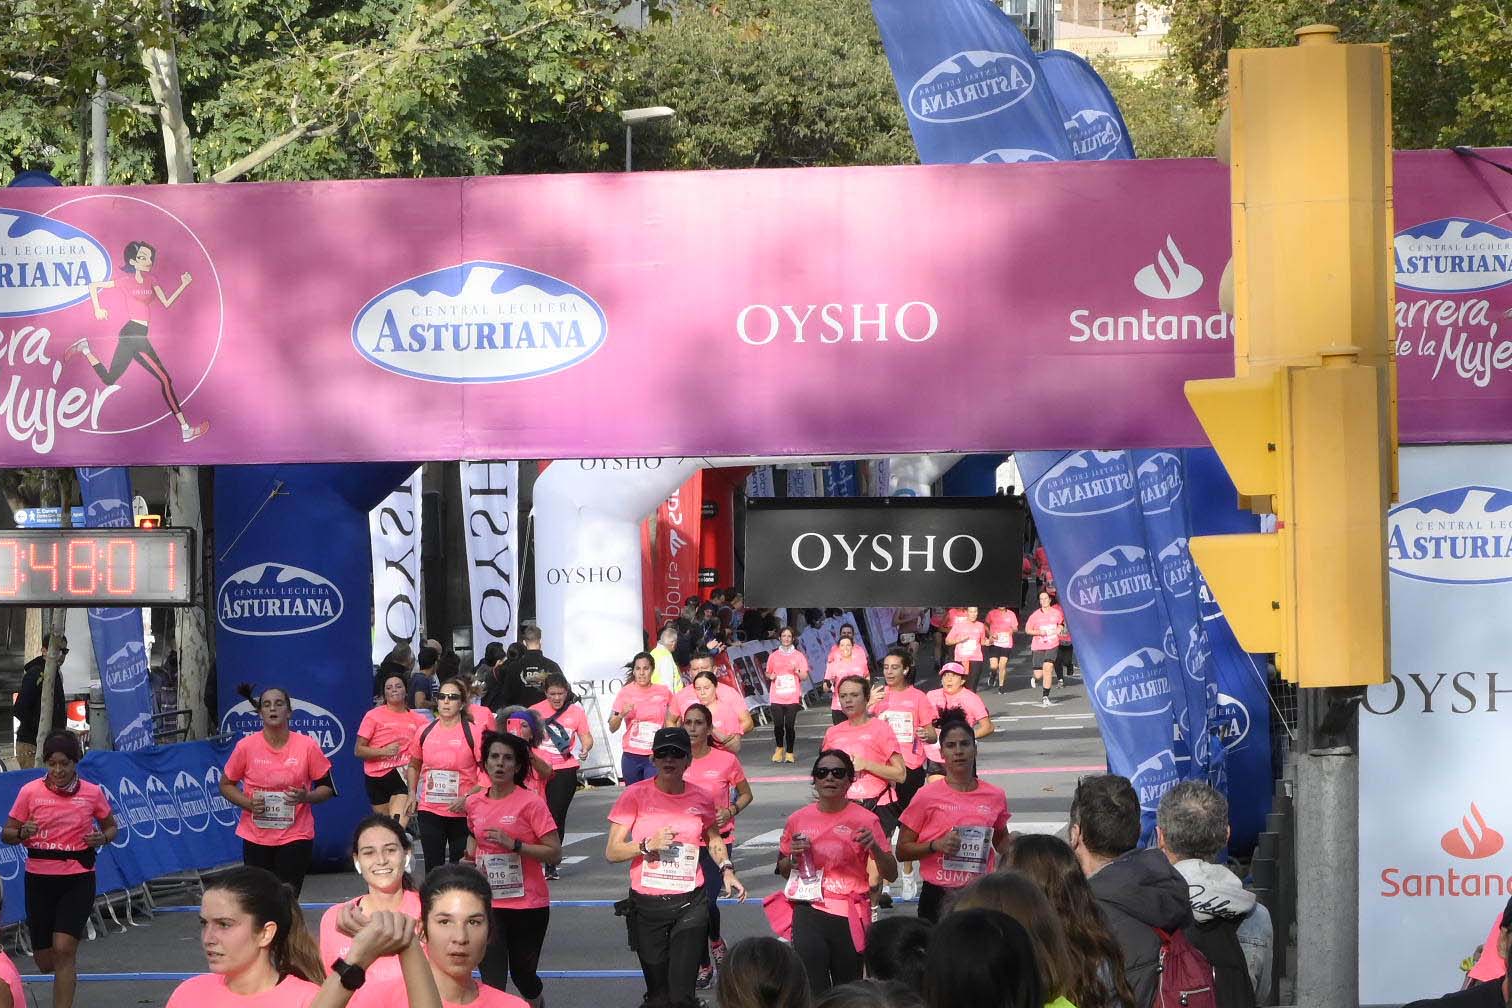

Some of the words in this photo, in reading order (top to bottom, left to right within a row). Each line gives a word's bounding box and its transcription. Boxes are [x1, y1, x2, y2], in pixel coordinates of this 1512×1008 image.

[15, 245, 86, 257] LECHERA
[1409, 243, 1459, 252] CENTRAL
[412, 303, 489, 316] CENTRAL
[498, 302, 579, 316] LECHERA
[1395, 299, 1490, 328] arrera
[372, 308, 587, 352] ASTURIANA
[736, 300, 939, 346] OYSHO
[1070, 309, 1235, 343] Santand
[1418, 330, 1436, 356] la
[1415, 520, 1482, 531] CENTRAL
[1489, 520, 1512, 531] LEC
[791, 532, 983, 574] OYSHO
[546, 565, 622, 585] OYSHO
[234, 587, 277, 597] CENTRAL
[281, 587, 330, 596] LECHERA
[221, 592, 334, 620] ASTURIANA
[961, 843, 980, 851] 016
[489, 871, 506, 879] 016
[1381, 867, 1512, 899] Santan
